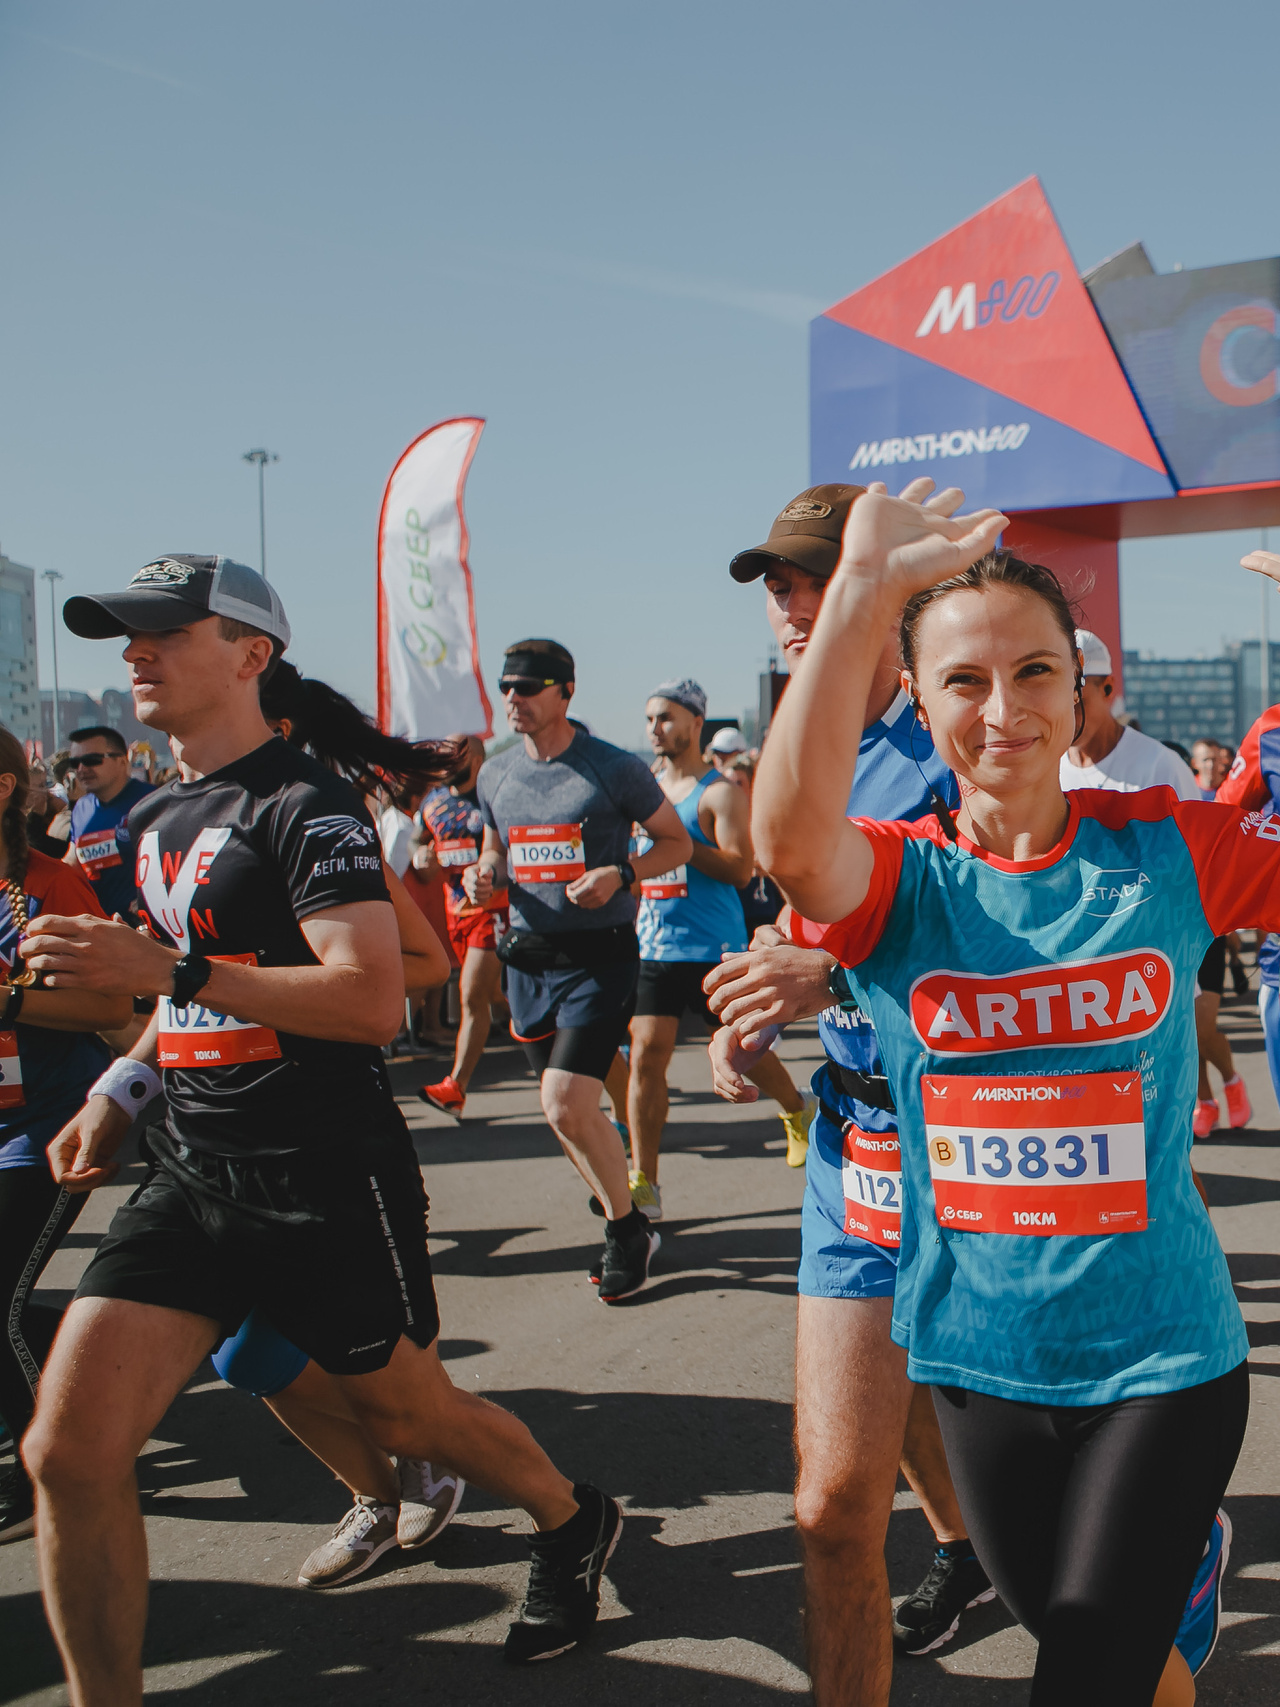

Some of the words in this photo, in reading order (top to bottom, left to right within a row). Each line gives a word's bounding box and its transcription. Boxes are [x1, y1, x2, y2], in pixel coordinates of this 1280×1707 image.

[521, 845, 576, 861] 10963
[135, 851, 215, 888] ONE
[313, 857, 350, 877] БЕГИ,
[1082, 872, 1151, 902] STADA
[166, 998, 250, 1028] 1029
[193, 1050, 221, 1061] 10KM
[936, 1141, 951, 1161] B
[958, 1133, 1110, 1179] 13831
[855, 1169, 902, 1208] 112
[956, 1208, 983, 1221] СБЕР
[1012, 1211, 1058, 1226] 10KM
[881, 1229, 901, 1241] 10K
[15, 1341, 30, 1362] PLAY
[23, 1361, 40, 1383] LOUD
